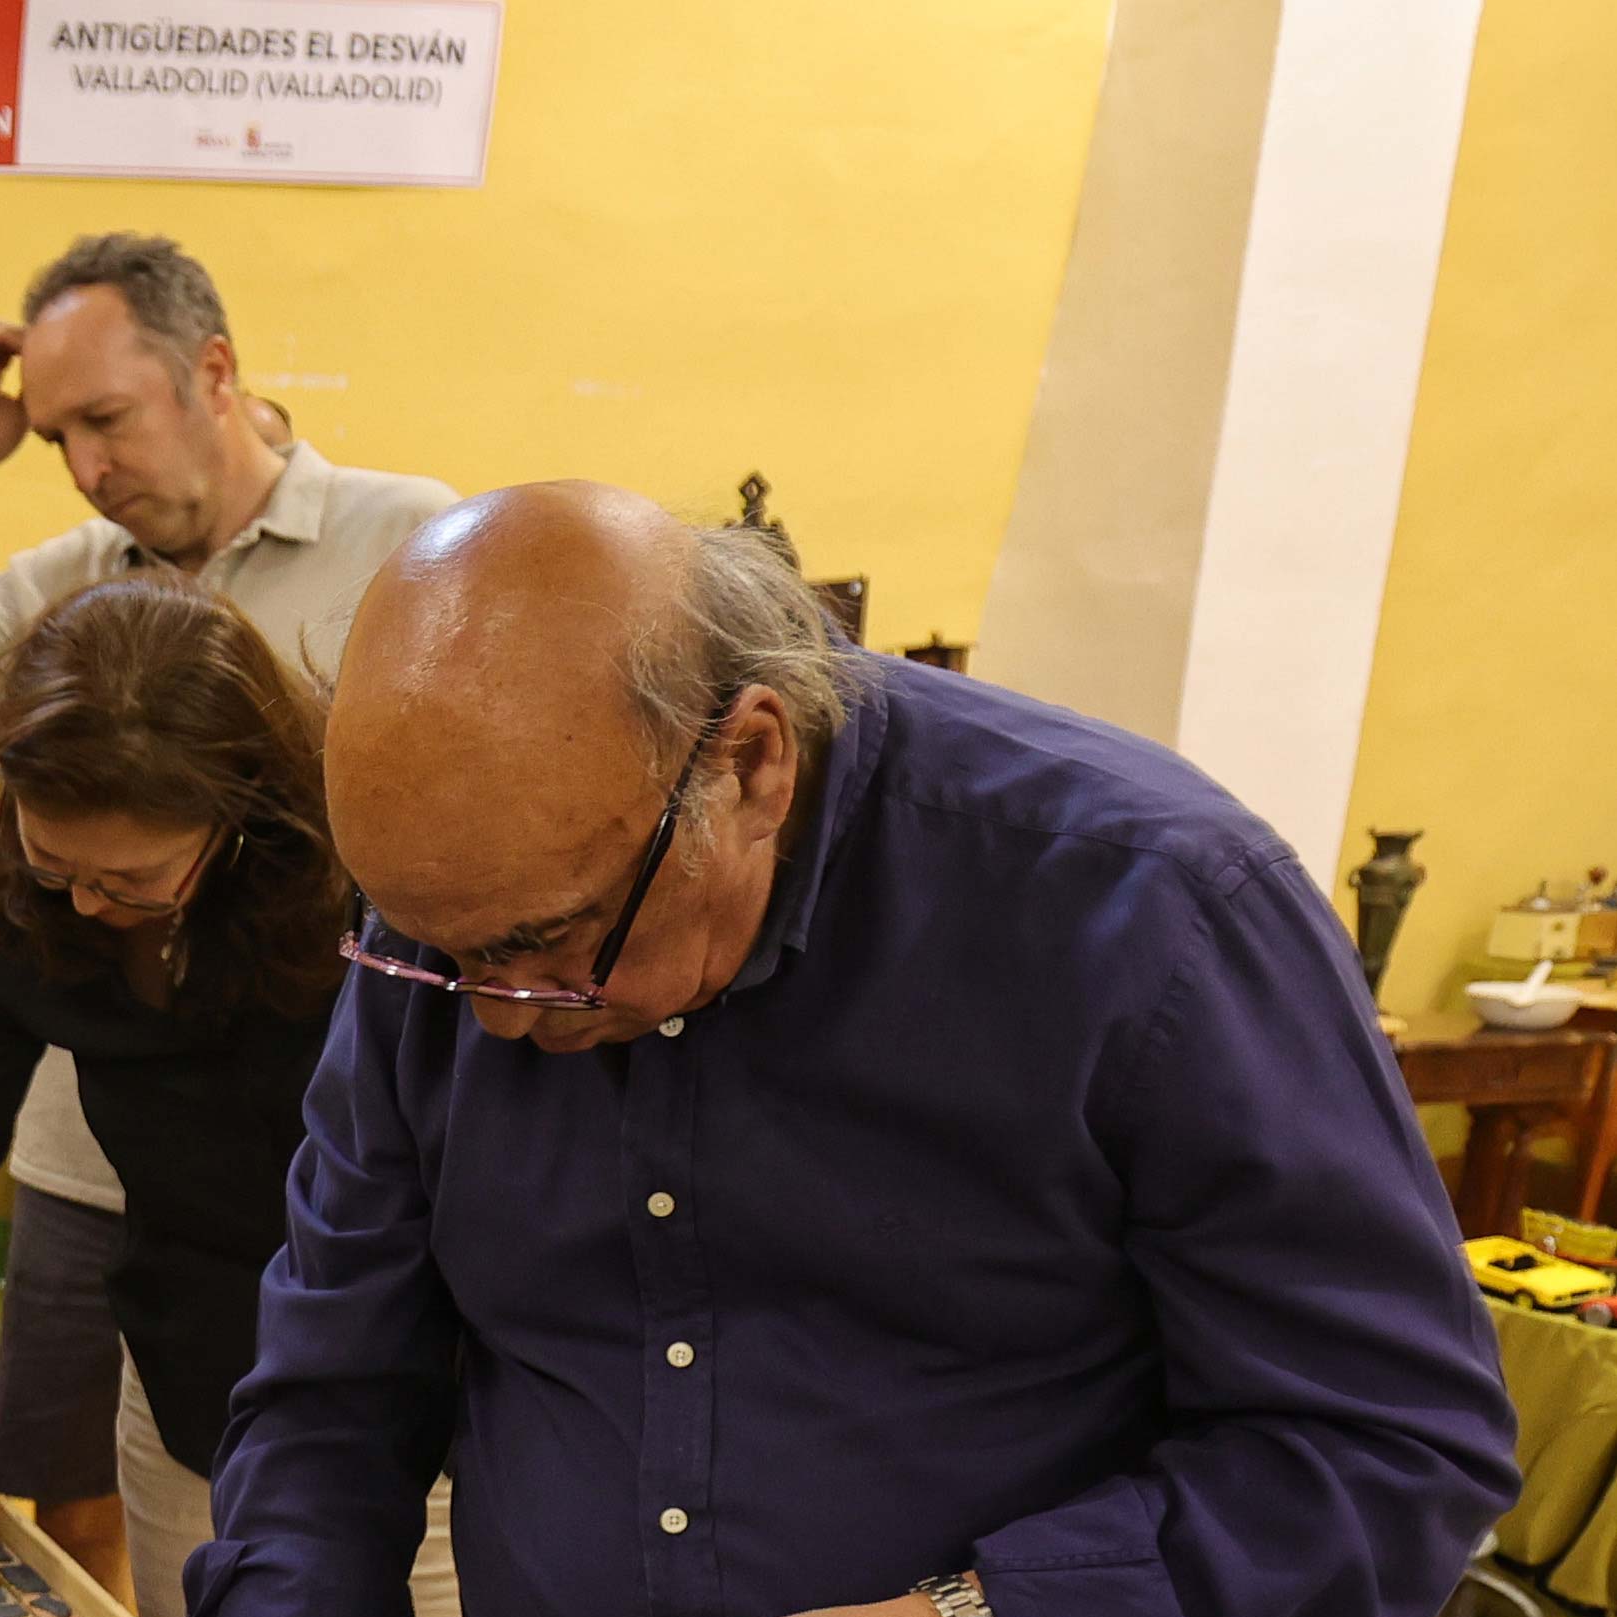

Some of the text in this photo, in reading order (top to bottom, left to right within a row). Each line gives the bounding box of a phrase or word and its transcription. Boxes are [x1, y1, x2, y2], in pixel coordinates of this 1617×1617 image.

[52, 17, 467, 65] ANTIGÜEDADES EL DESVÁN
[73, 65, 443, 107] VALLADOLID (VALLADOLID)
